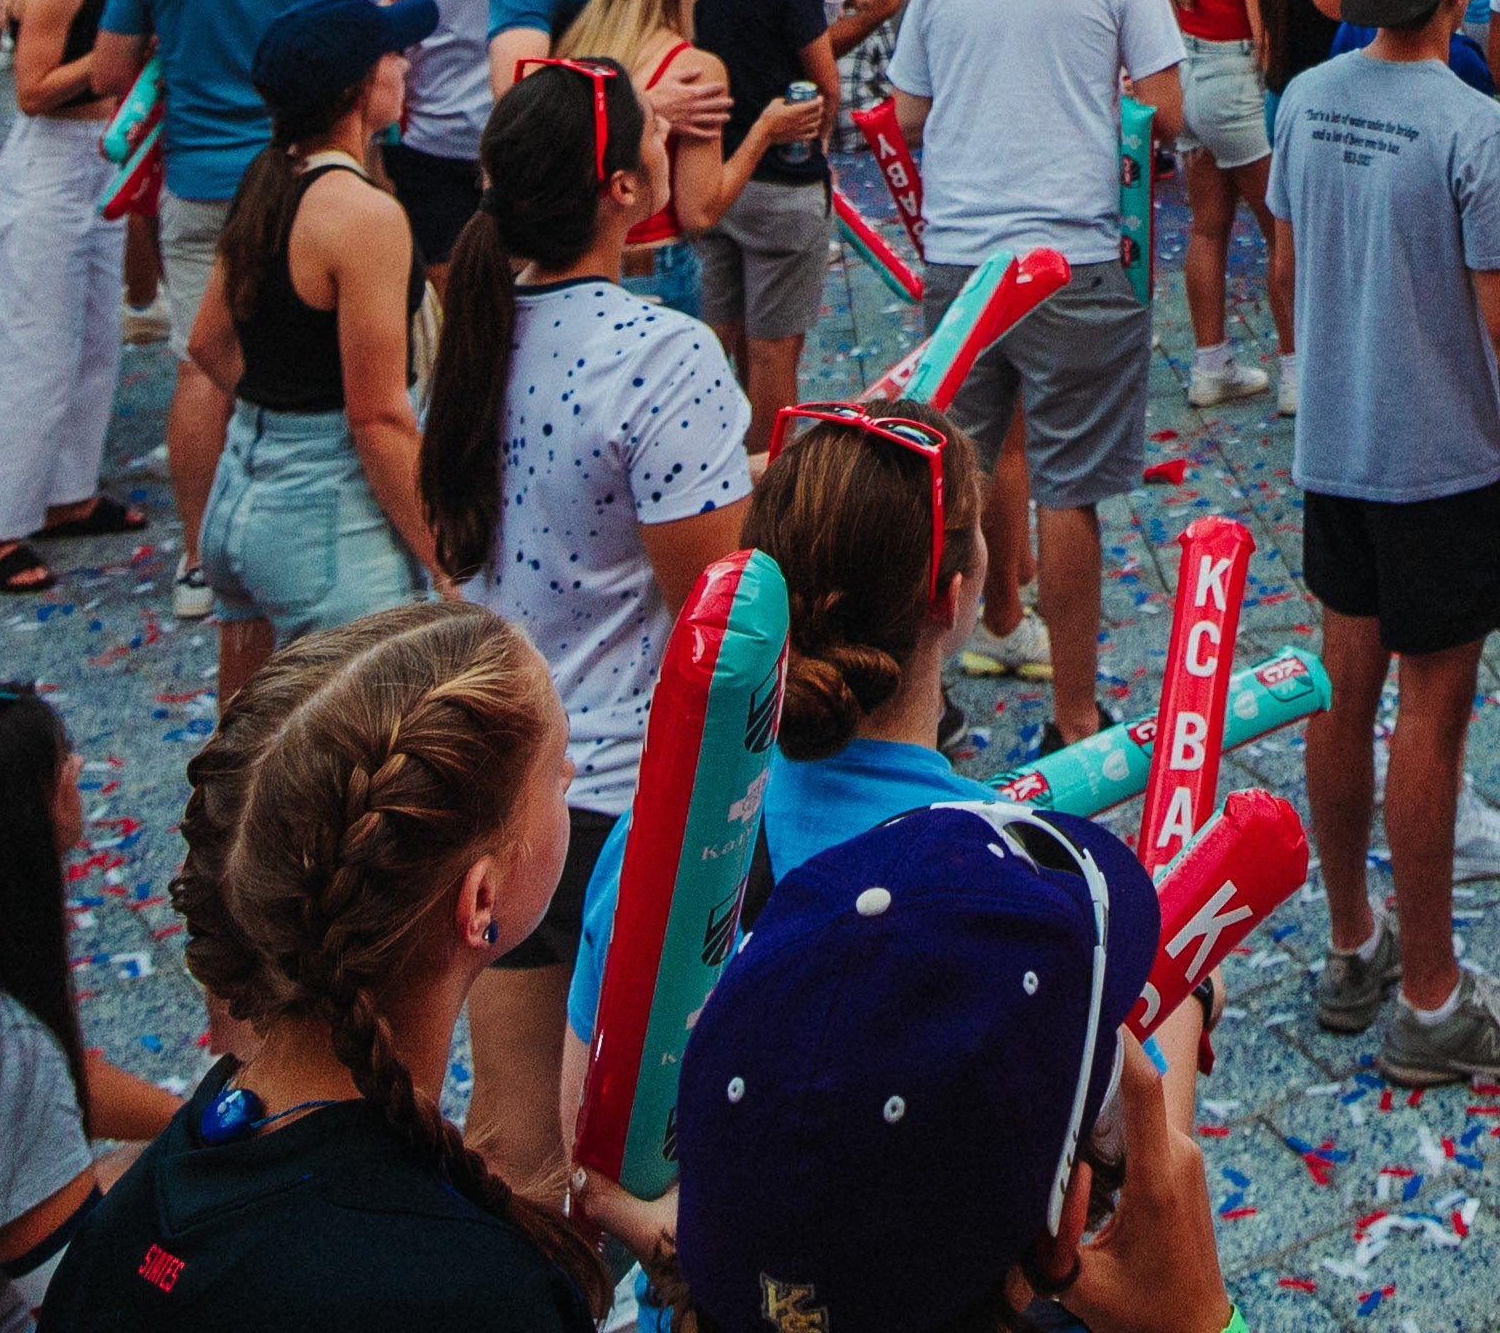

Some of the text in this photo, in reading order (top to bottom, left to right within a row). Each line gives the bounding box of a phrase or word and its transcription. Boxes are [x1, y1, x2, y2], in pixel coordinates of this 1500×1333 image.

[1261, 657, 1308, 686] KC
[1156, 555, 1232, 851] KC BA
[138, 1243, 186, 1293] STATES
